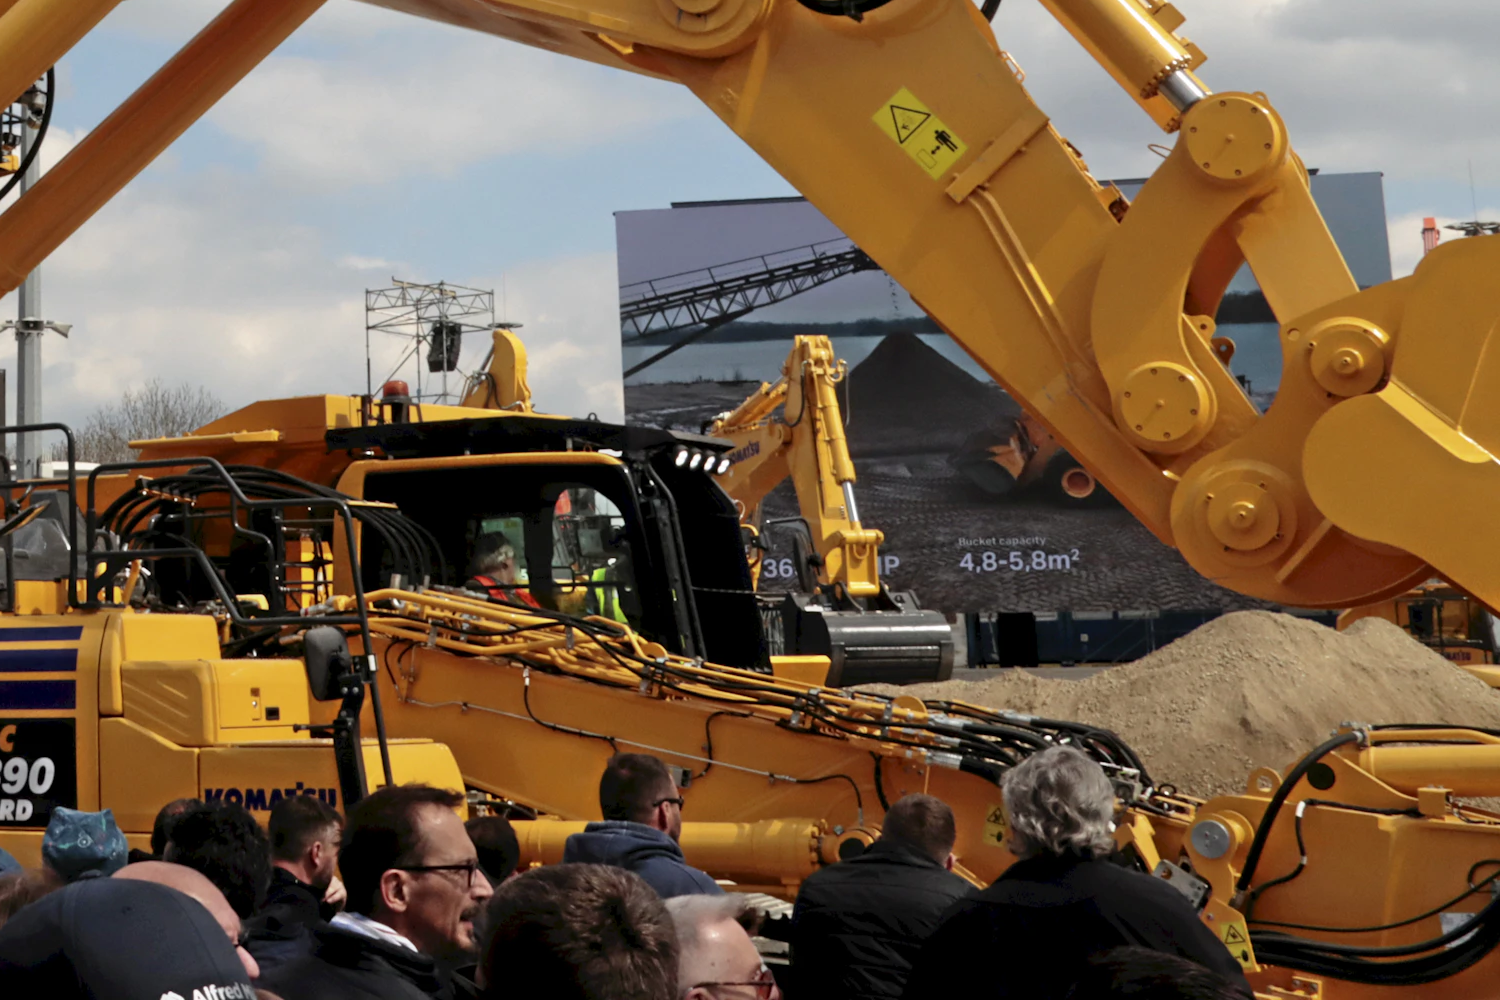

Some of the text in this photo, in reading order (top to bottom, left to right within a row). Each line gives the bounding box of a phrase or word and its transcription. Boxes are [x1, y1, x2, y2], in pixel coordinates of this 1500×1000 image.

[958, 536, 1047, 547] Bucket capacity
[763, 558, 799, 579] 36
[192, 981, 243, 1000] Alfred
